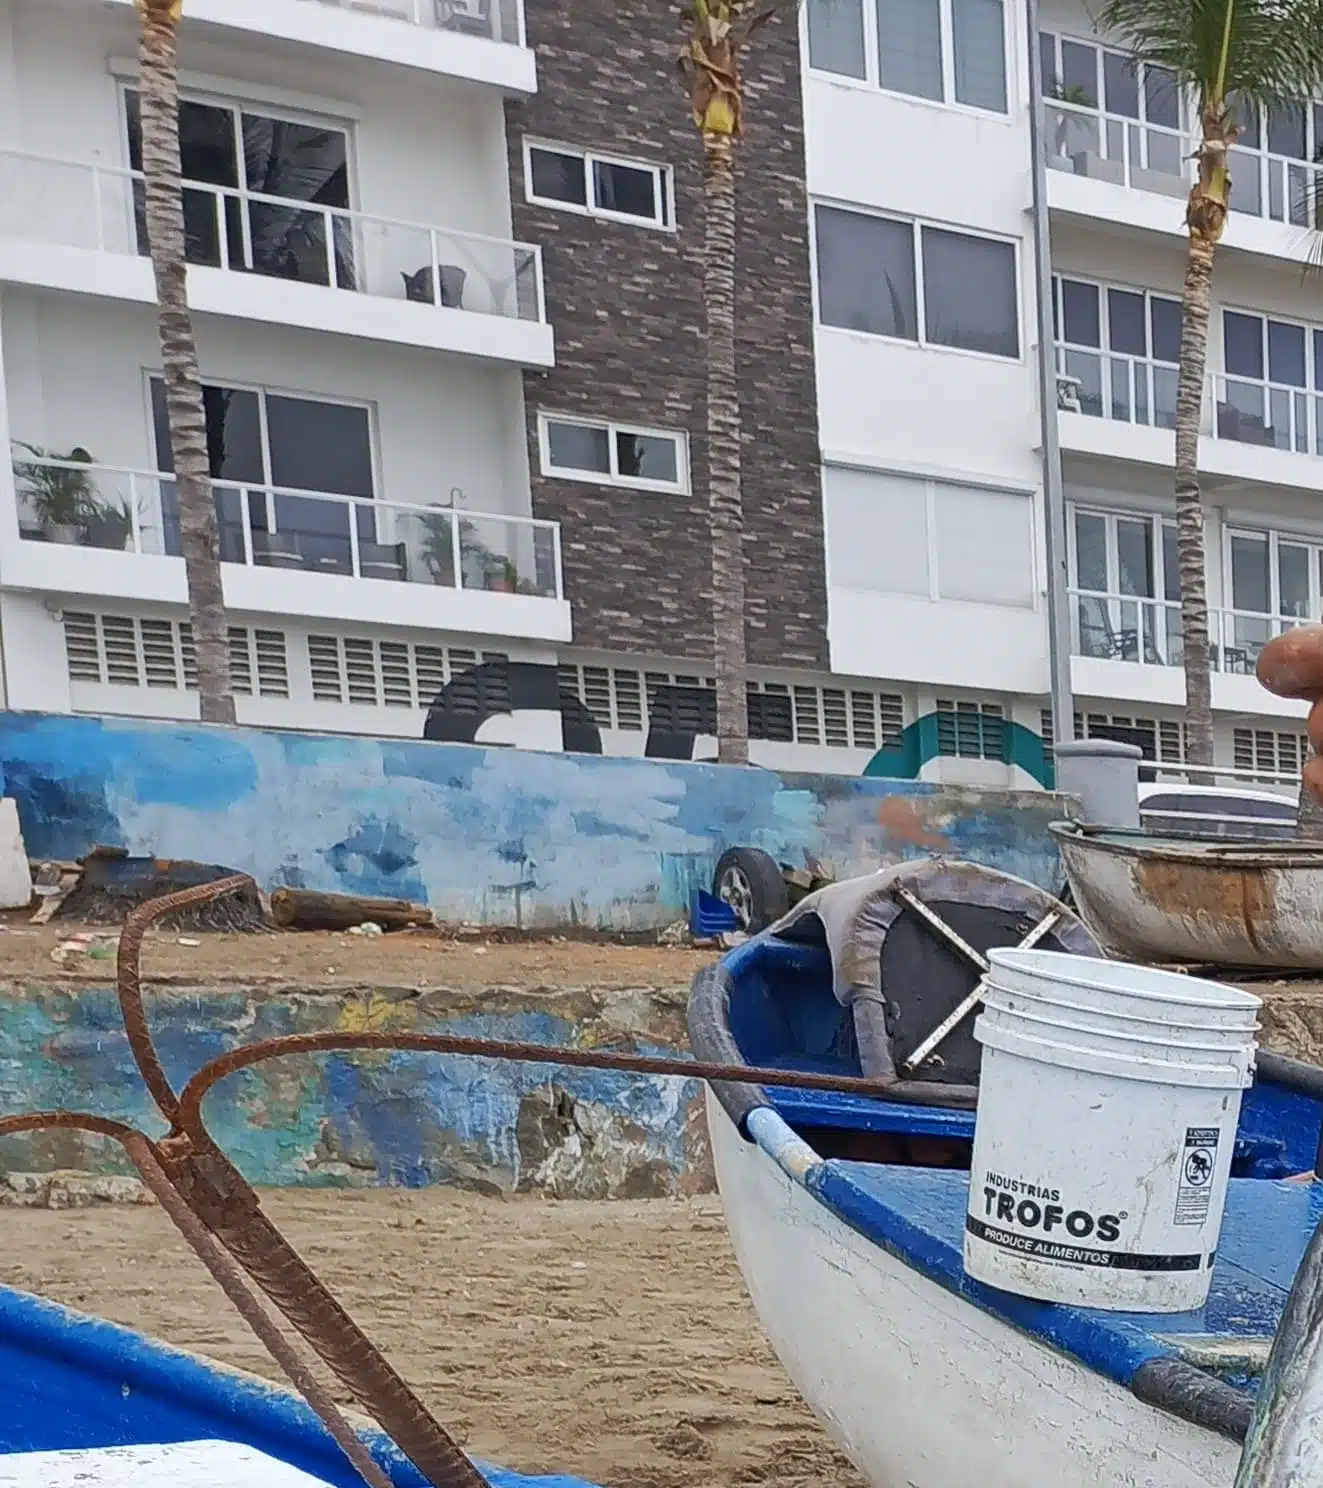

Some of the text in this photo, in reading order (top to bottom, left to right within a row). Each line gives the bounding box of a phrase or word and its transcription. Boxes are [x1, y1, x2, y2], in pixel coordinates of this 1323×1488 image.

[985, 1170, 1060, 1202] INDUSTRIAS
[983, 1227, 1033, 1251] PRODUCE
[1034, 1241, 1110, 1264] ALIMENTOS
